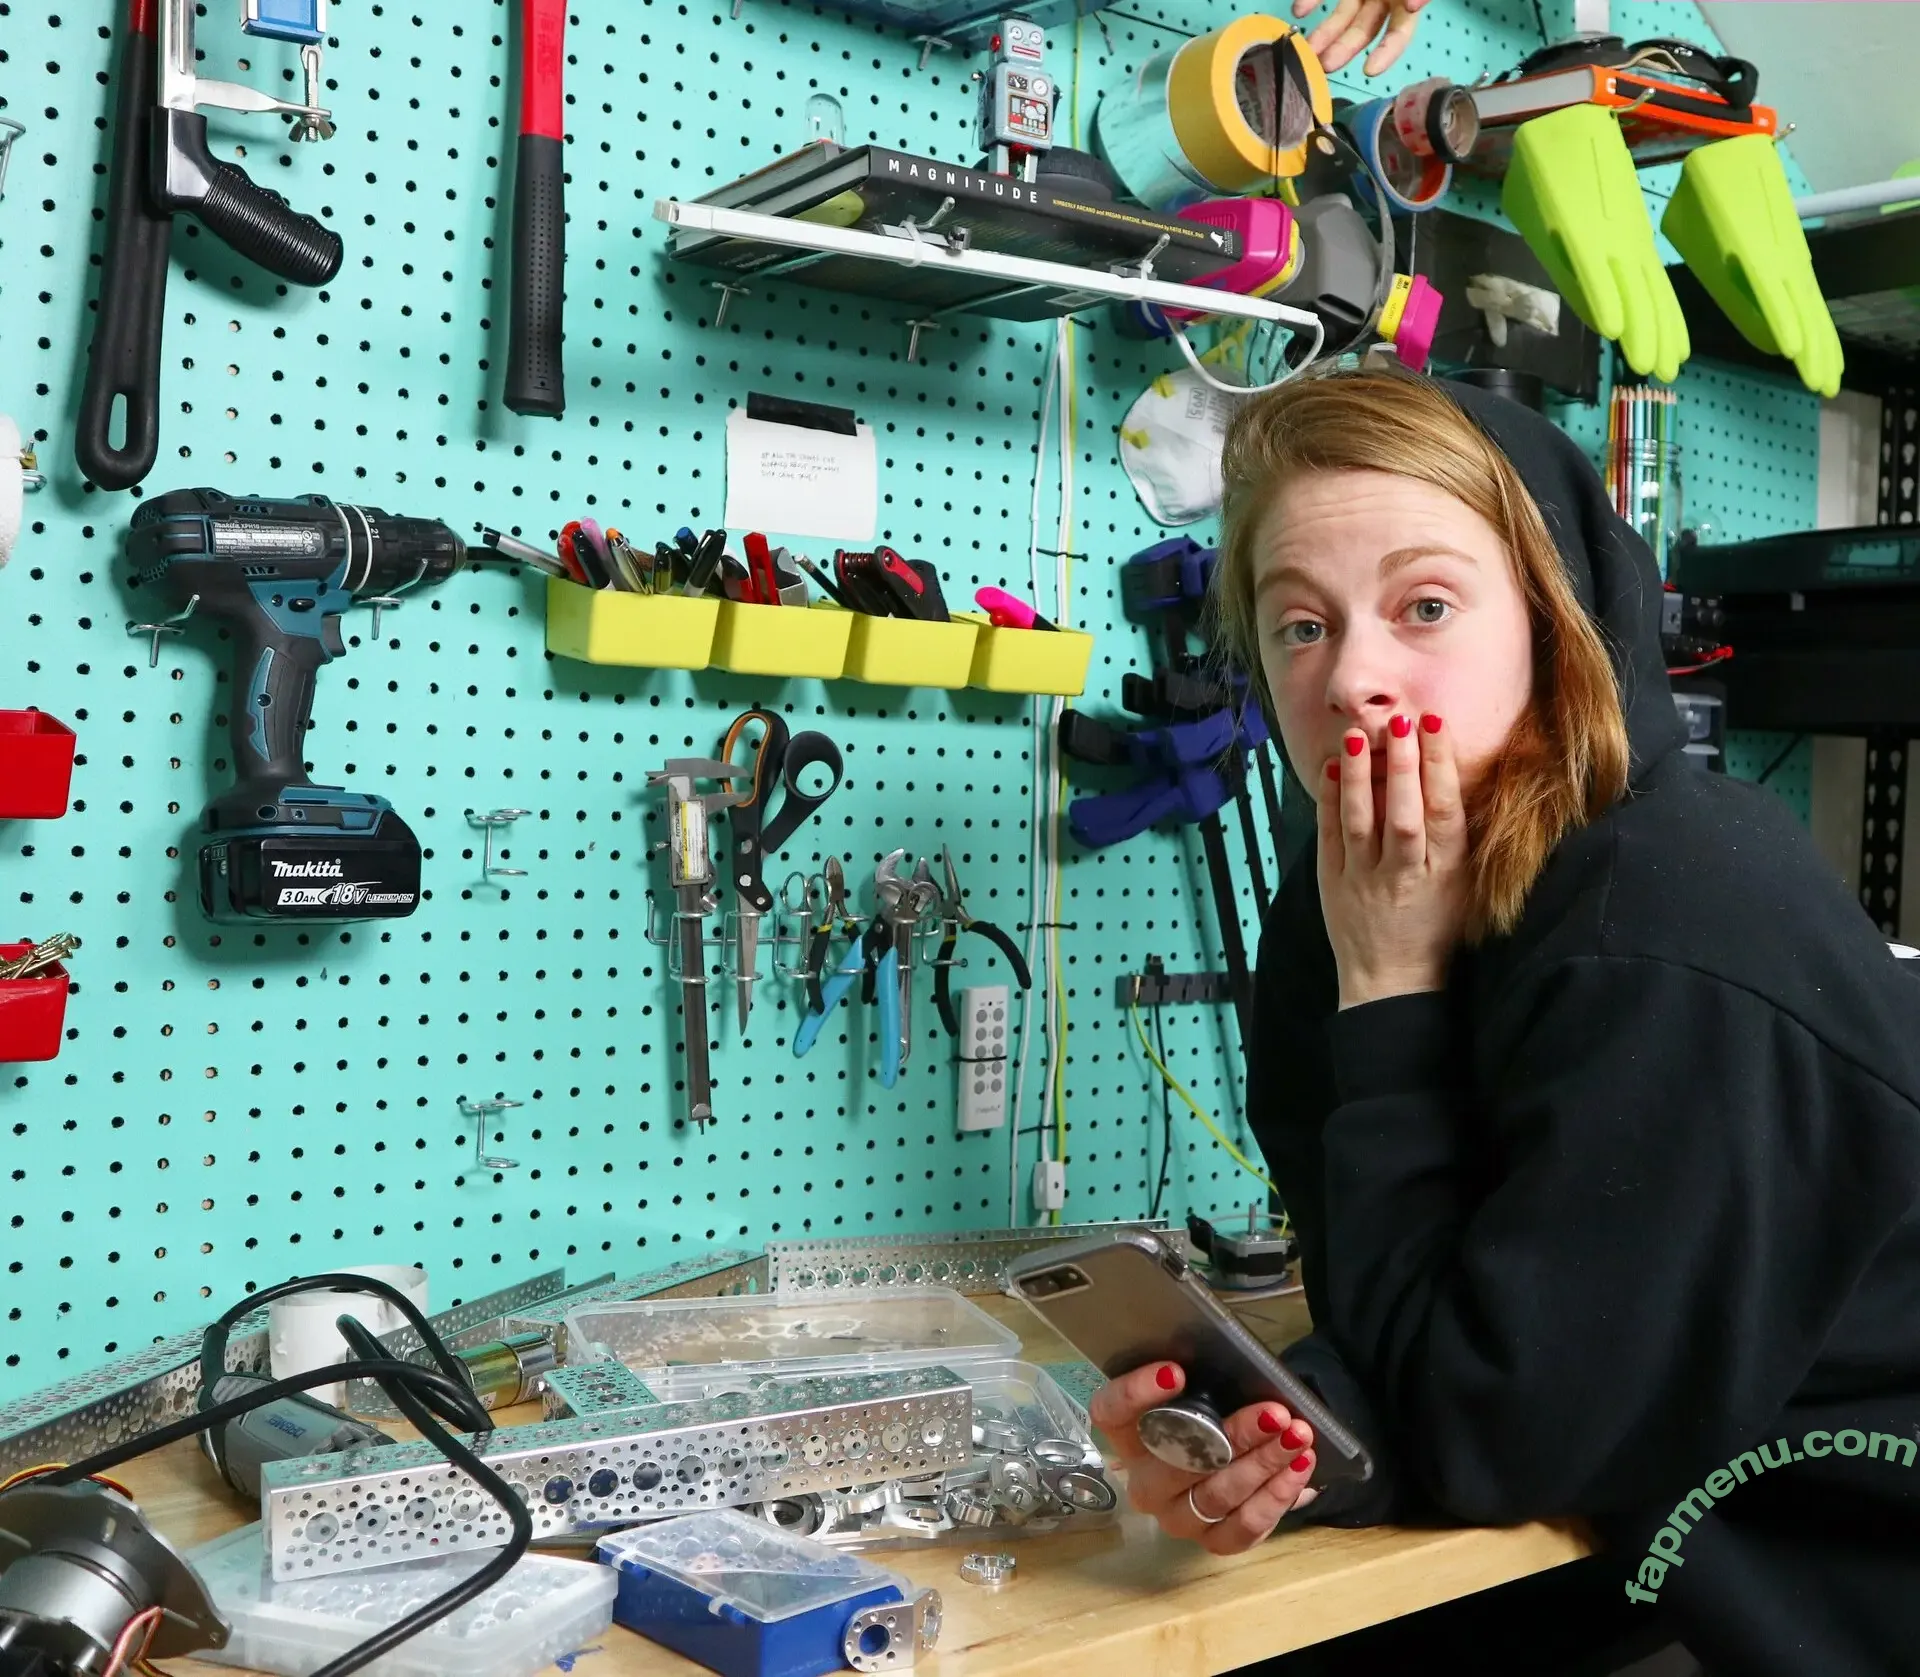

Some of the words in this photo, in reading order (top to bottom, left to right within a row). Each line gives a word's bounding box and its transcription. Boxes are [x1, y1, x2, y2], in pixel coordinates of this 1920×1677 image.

[888, 159, 1038, 203] MAGNITUDE
[1190, 390, 1204, 416] N95
[371, 527, 380, 539] 21
[282, 890, 316, 903] 3.0Ah
[365, 893, 415, 904] LITHIUM-ION
